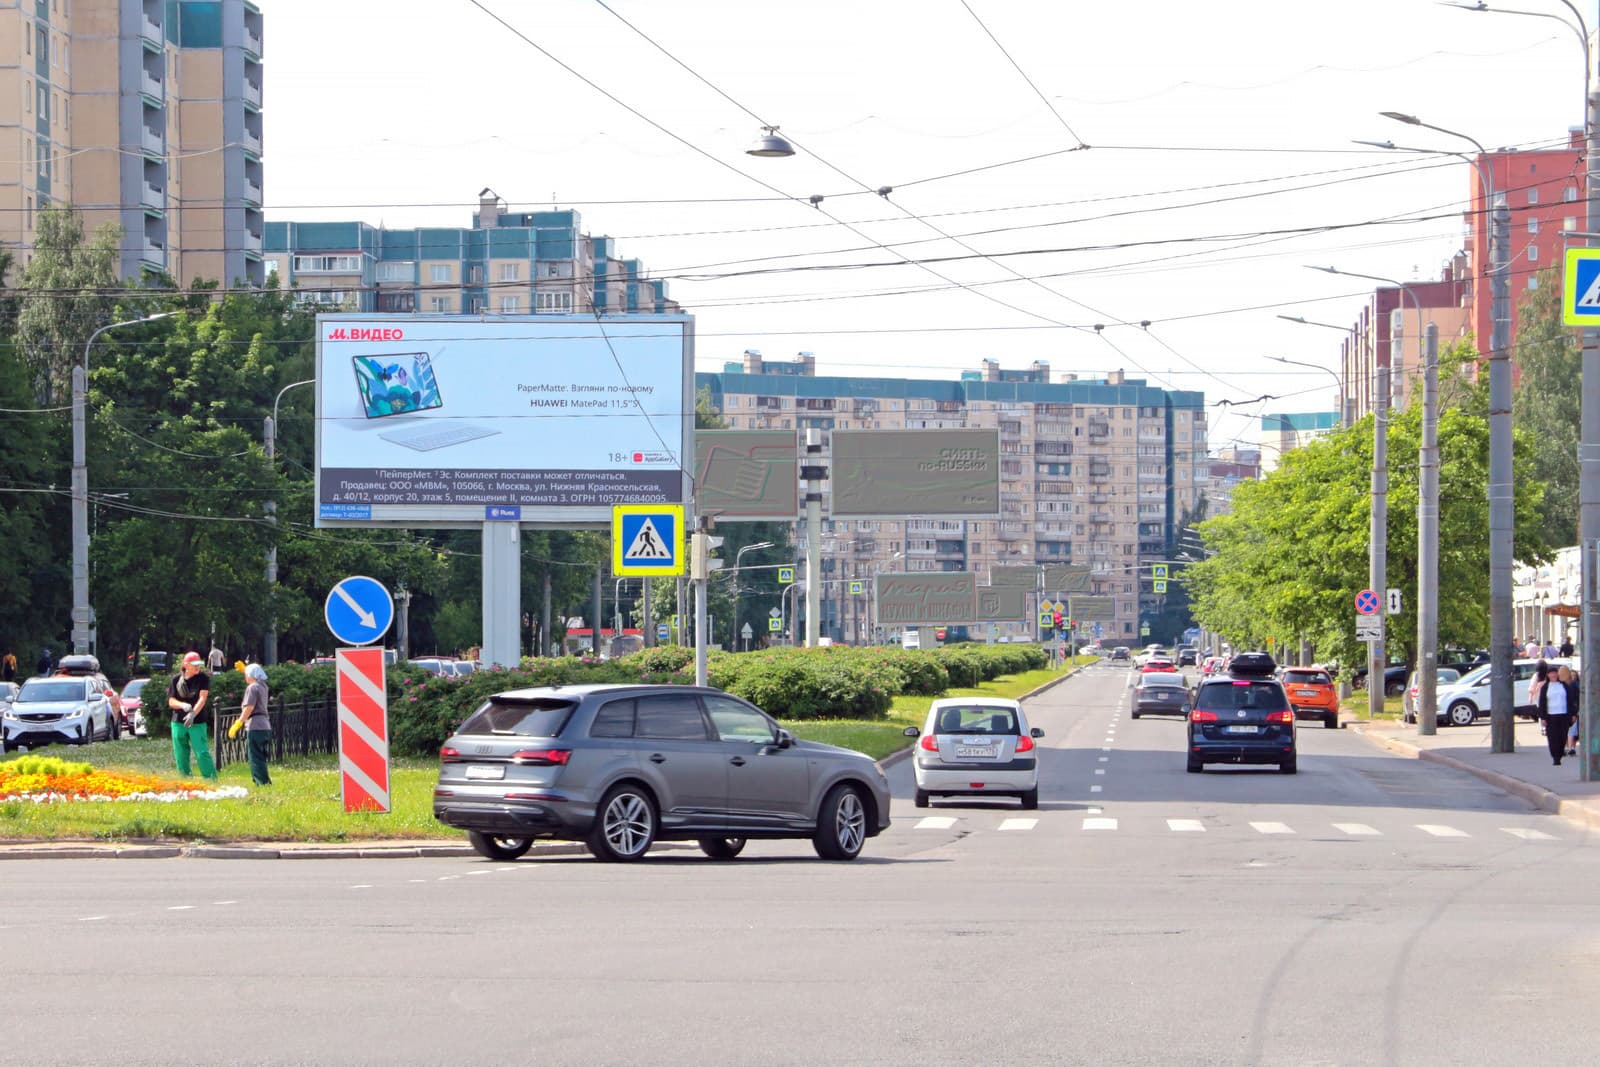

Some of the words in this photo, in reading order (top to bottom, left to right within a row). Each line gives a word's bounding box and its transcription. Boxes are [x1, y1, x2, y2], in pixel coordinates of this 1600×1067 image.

[571, 384, 605, 392] Взгляни
[607, 385, 654, 394] по-новому
[530, 399, 568, 408] HUAWEI
[571, 399, 608, 408] MatePad
[608, 453, 628, 462] 18+
[455, 471, 498, 480] Комплект
[500, 472, 541, 480] поставки
[575, 473, 626, 481] отличаться.
[340, 481, 387, 490] Продавец:
[389, 481, 412, 490] ООО
[452, 482, 485, 491] 105066,
[496, 482, 533, 491] Москва,
[534, 484, 548, 492] ул.
[550, 483, 585, 491] Нижняя
[333, 493, 341, 501] д.
[343, 492, 371, 502] 40/12,
[373, 494, 404, 503] корпус
[406, 493, 419, 502] 20,
[445, 493, 453, 502] 5,
[455, 494, 507, 502] помещение
[570, 494, 596, 503] ОГРН
